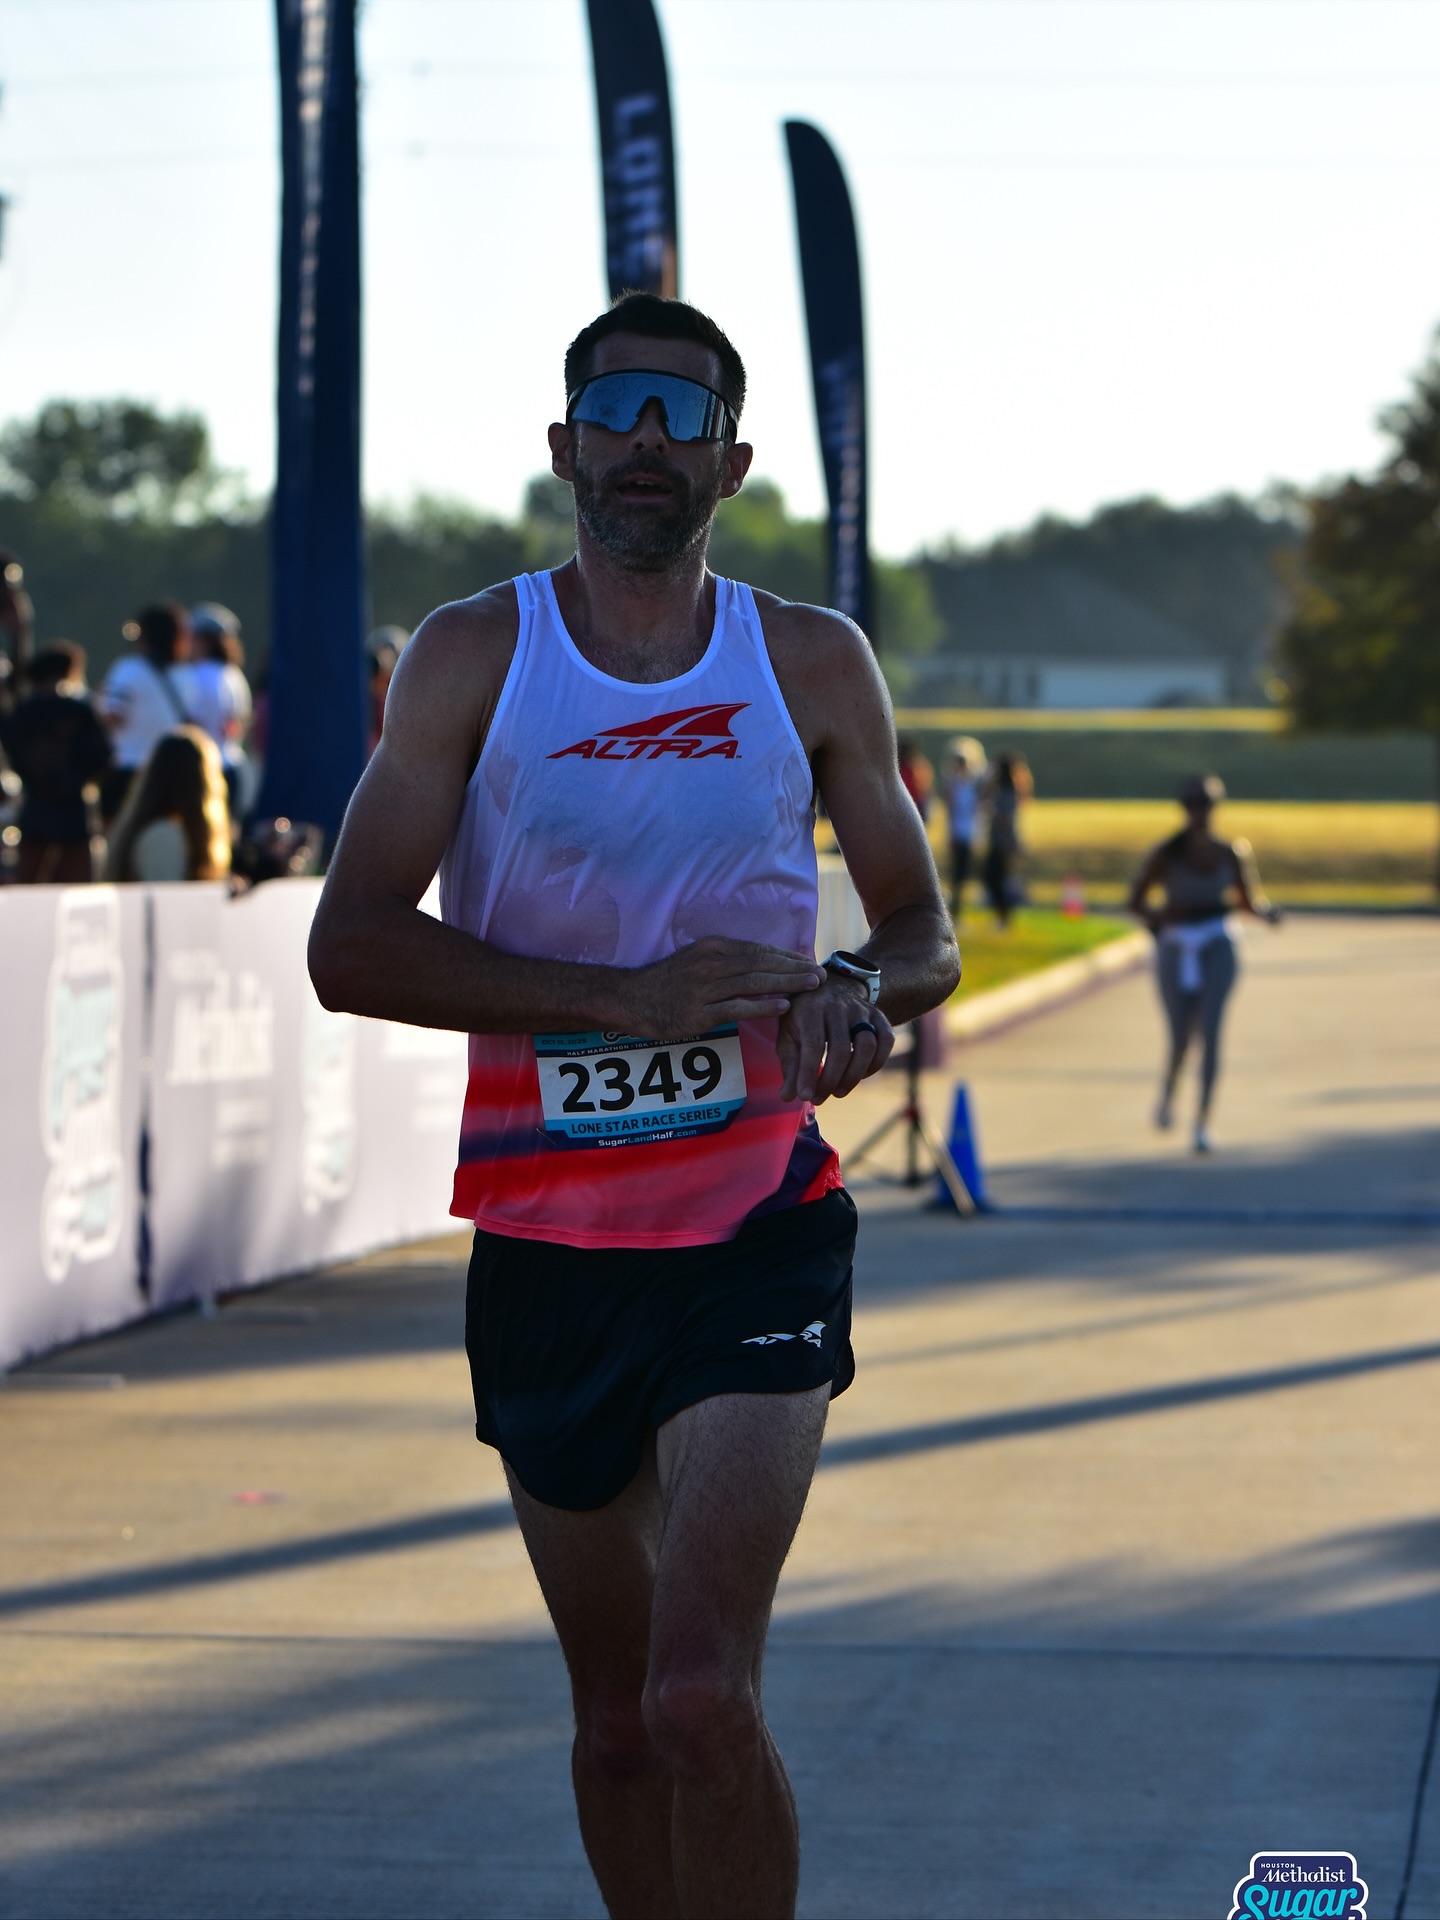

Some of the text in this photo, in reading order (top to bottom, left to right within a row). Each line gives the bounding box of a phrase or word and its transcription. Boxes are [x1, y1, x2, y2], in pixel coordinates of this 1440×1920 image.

[546, 739, 739, 760] ALTRA
[588, 1044, 630, 1055] MARATHON
[655, 1037, 681, 1047] FAMILY
[558, 1046, 722, 1113] 2349
[571, 1107, 722, 1135] LONE STAR RACE SERIES
[598, 1129, 697, 1147] SugarLandHalf.com
